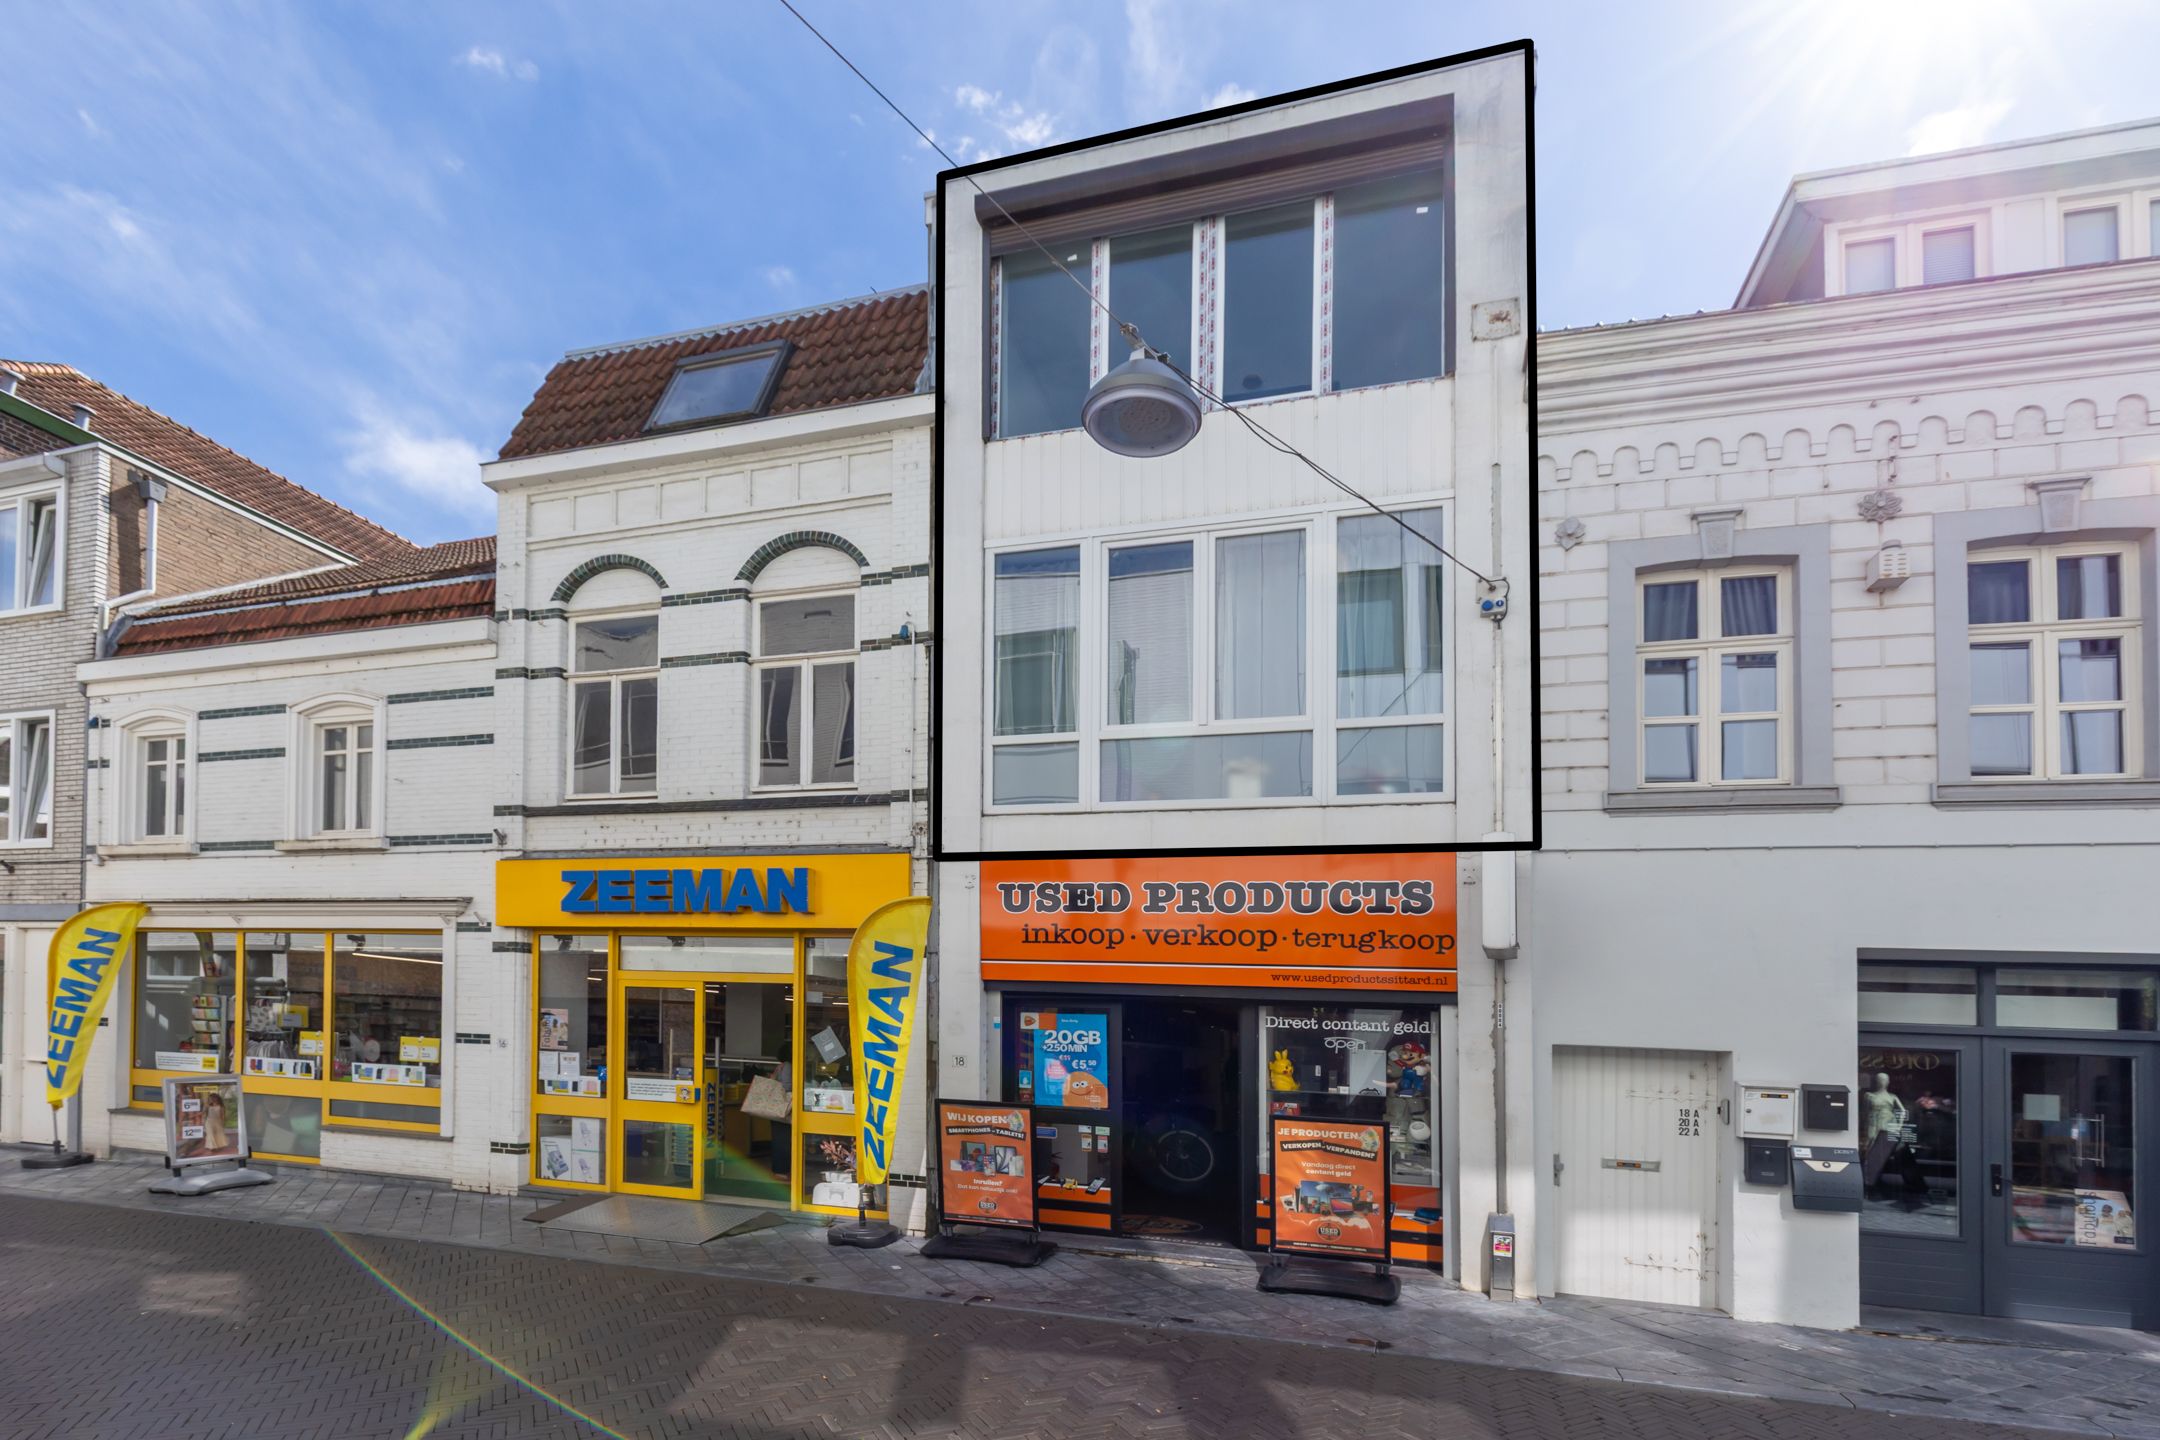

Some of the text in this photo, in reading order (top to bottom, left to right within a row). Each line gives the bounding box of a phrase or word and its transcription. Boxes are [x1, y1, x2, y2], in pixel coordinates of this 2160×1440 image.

[561, 868, 812, 913] ZEEMAN
[997, 880, 1434, 916] USED PRODUCTS
[1021, 923, 1455, 955] inkoop verkoop terugkoop
[1271, 972, 1449, 986] www.usedproductssittard.nl
[1265, 1016, 1318, 1030] Direct
[1322, 1020, 1390, 1032] contant
[1044, 1030, 1102, 1045] 20GB
[1324, 1037, 1367, 1054] open
[863, 940, 914, 1171] ZEEMAN
[955, 1056, 965, 1066] 18
[947, 1112, 1008, 1125] WIJ KOPEN
[1679, 1109, 1700, 1118] 18 A
[1678, 1118, 1700, 1128] 20 A
[1277, 1127, 1359, 1140] JE PRODUCTEN
[1678, 1127, 1700, 1137] 22 A
[1282, 1142, 1376, 1159] VERKOPEN VERPANDEN?
[2079, 1192, 2096, 1246] Fabulous
